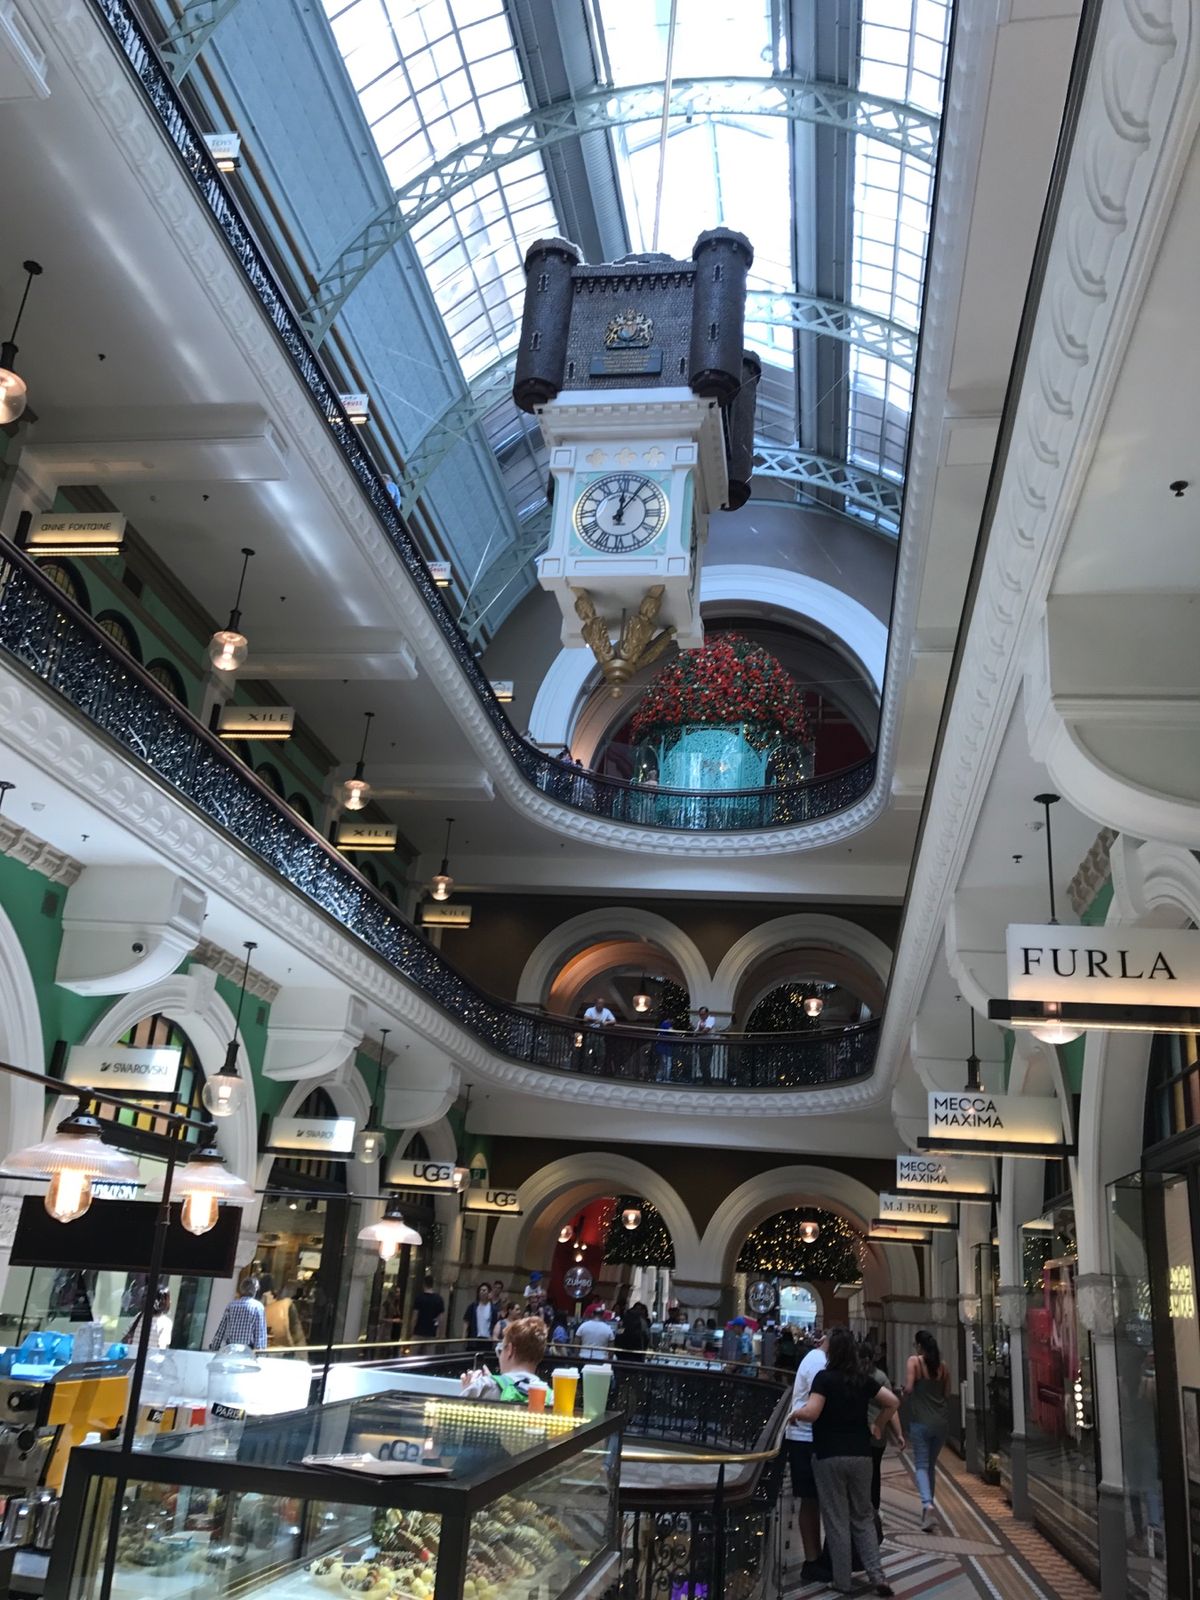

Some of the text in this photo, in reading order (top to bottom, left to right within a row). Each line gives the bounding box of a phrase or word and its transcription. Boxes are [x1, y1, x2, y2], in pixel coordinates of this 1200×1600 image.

[248, 713, 288, 721] XILE
[353, 829, 392, 837] XILE
[1020, 947, 1177, 980] FURLA
[113, 1063, 168, 1074] SWAROVSKI
[934, 1098, 997, 1112] MECCA
[934, 1113, 1004, 1128] MAXIMA
[413, 1163, 450, 1182] UGG
[900, 1162, 943, 1173] MECCA
[900, 1173, 948, 1184] MAXIMA
[486, 1191, 517, 1207] UGG
[215, 1405, 243, 1419] PARIS
